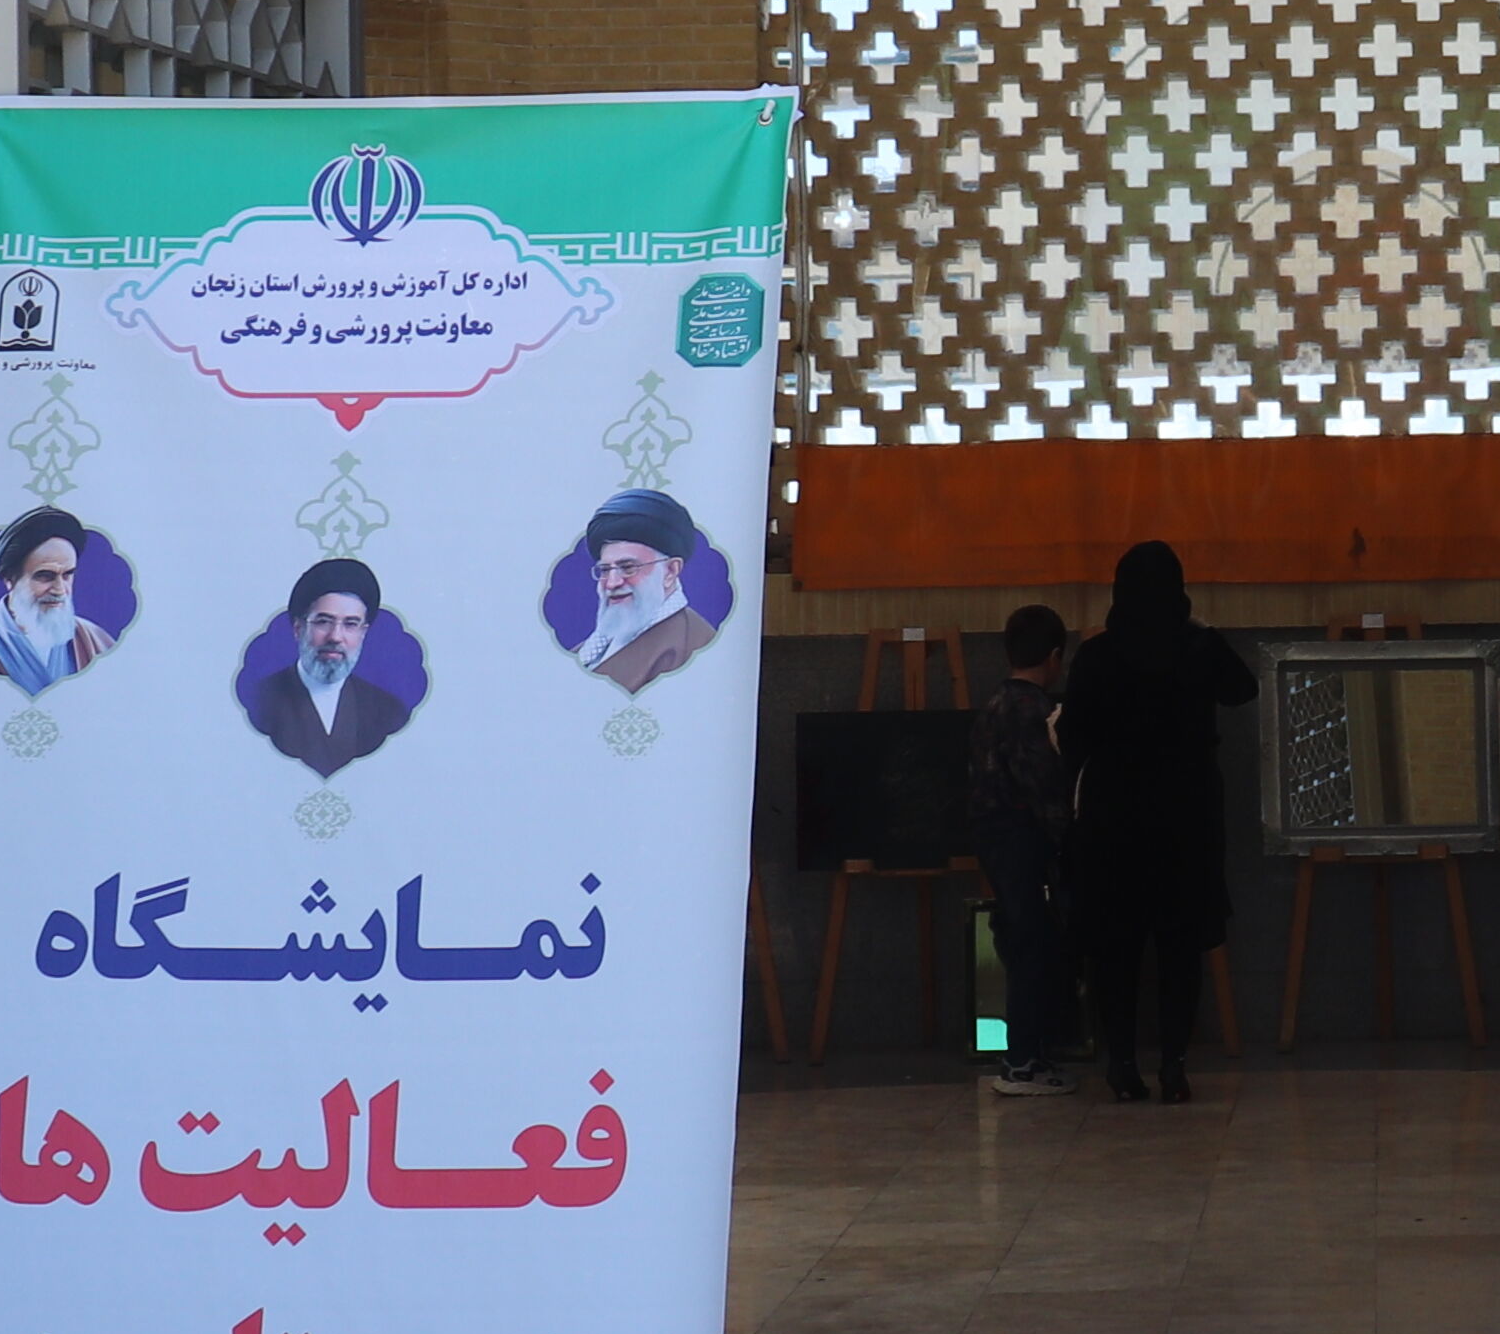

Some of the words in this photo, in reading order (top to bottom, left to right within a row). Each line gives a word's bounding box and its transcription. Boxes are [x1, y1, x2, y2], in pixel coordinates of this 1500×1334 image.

[191, 274, 245, 298] زنجان
[250, 273, 299, 297] استان
[302, 273, 365, 299] پرورش
[369, 281, 378, 297] و
[381, 270, 449, 297] آموزش
[452, 272, 480, 295] کل
[483, 271, 527, 296] اداره
[220, 312, 307, 345] فرهنگی
[309, 323, 322, 344] و
[325, 314, 413, 345] پرورشی
[415, 312, 494, 344] معاونت
[10, 357, 53, 372] پرورشی
[57, 358, 96, 372] معاونت
[35, 871, 607, 1014] نمایشگاه
[139, 1068, 629, 1247] فعالیت
